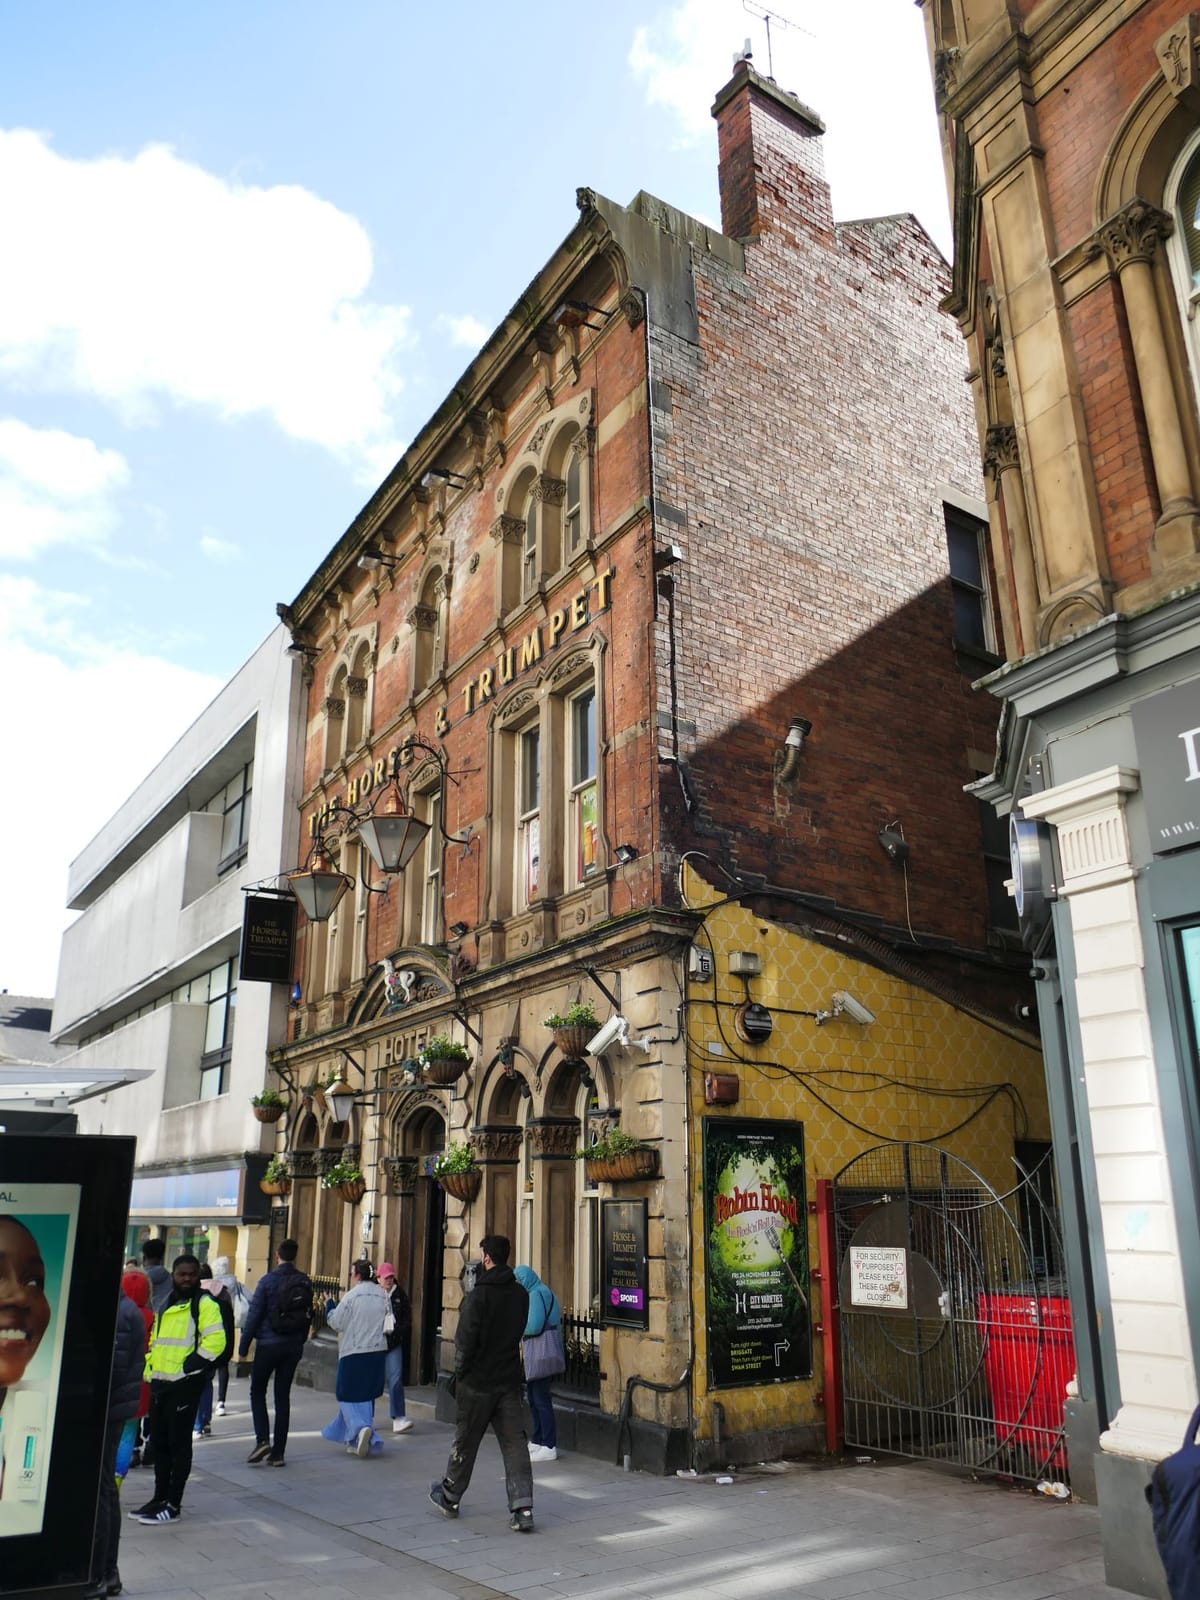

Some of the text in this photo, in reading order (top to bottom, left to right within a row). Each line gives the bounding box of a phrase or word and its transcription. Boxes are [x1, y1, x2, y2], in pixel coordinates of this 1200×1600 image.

[308, 567, 615, 838] THE HORSE & TRUMPET
[251, 925, 279, 936] HORSE
[249, 934, 288, 945] TRUMPET
[715, 1183, 798, 1227] Robin Hood
[612, 1231, 631, 1242] HORSE
[612, 1242, 637, 1253] TRUMPET
[856, 1252, 899, 1261] FOR SECURITY
[862, 1262, 894, 1271] PURPOSES
[858, 1272, 898, 1281] PLEASE KEEP
[858, 1282, 878, 1291] THESE
[620, 1293, 638, 1303] SPORTS
[750, 1294, 783, 1304] CITY VARIETIES
[866, 1292, 891, 1302] CLOSED
[730, 1348, 753, 1356] BRIGGATE
[731, 1362, 761, 1372] SWAN STREET
